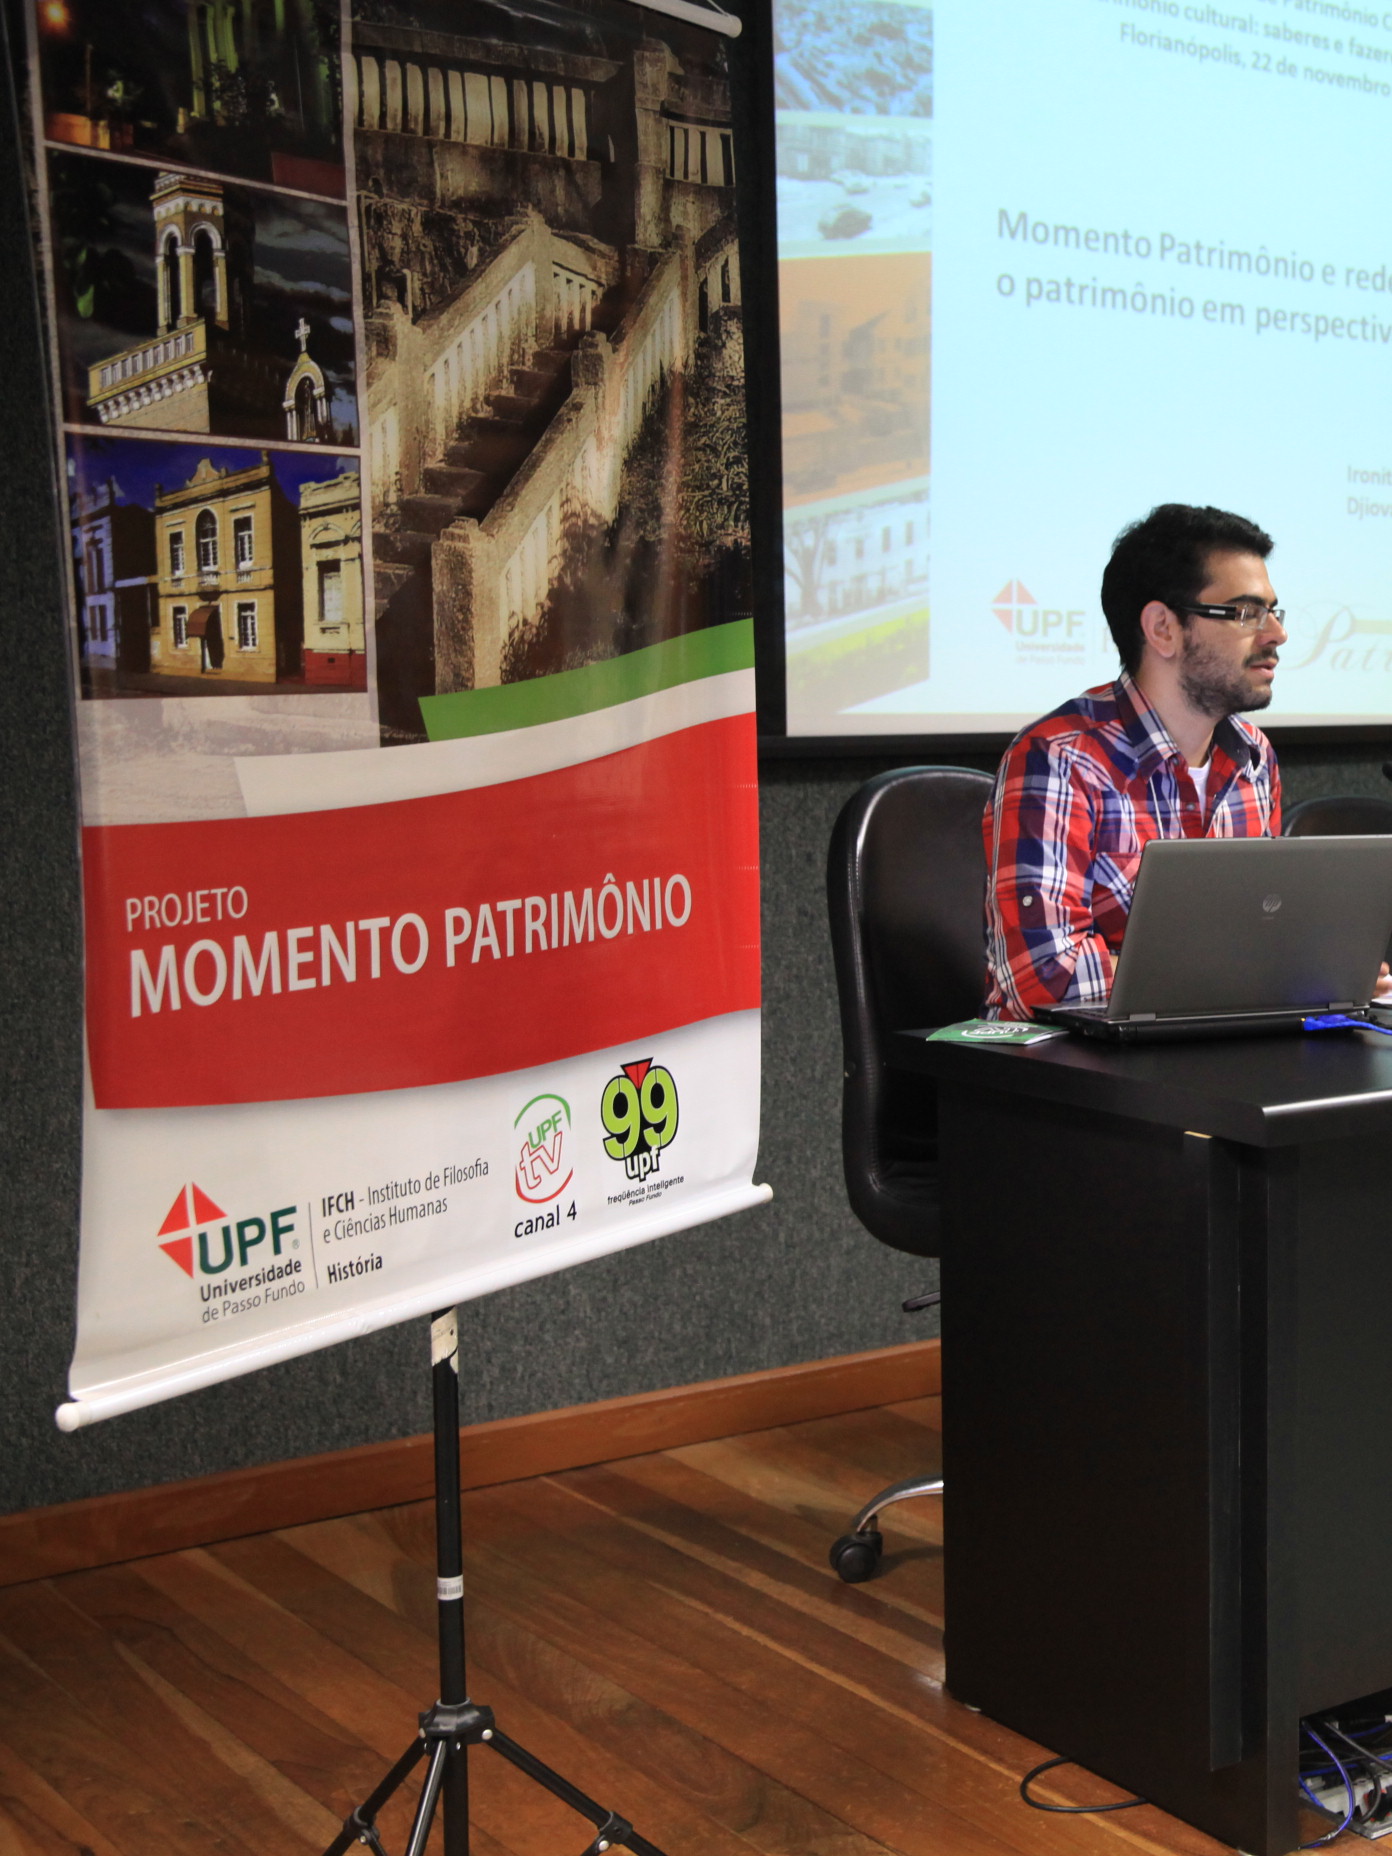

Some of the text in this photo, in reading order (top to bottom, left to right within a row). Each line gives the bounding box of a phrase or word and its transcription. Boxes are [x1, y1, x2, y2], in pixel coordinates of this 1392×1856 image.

[1183, 3, 1259, 36] cultural:
[1263, 21, 1330, 51] saberes
[1333, 37, 1343, 54] e
[1119, 21, 1246, 71] Florianópolis,
[1251, 50, 1272, 73] 22
[1276, 55, 1297, 77] de
[1303, 64, 1391, 98] novembro
[997, 207, 1152, 259] Momento
[1159, 231, 1314, 282] Patrimônio
[1321, 263, 1335, 285] e
[996, 272, 1015, 297] o
[1026, 276, 1195, 321] patrimônio
[1202, 299, 1245, 326] em
[1016, 608, 1086, 638] UPF
[126, 885, 249, 932] PROJETO
[130, 872, 692, 1019] MOMENTO PATRIMÔNIO
[528, 1110, 562, 1150] UPF
[600, 1065, 679, 1161] 99
[625, 1145, 660, 1182] upf
[322, 1157, 489, 1218] IFCH Instituto de Filosofia
[198, 1205, 297, 1275] UPF
[323, 1197, 448, 1244] e Ciências Humanas
[514, 1200, 577, 1239] canal 4
[200, 1259, 301, 1303] Universidade
[327, 1252, 383, 1284] História
[202, 1280, 305, 1324] de Passo Fundo
